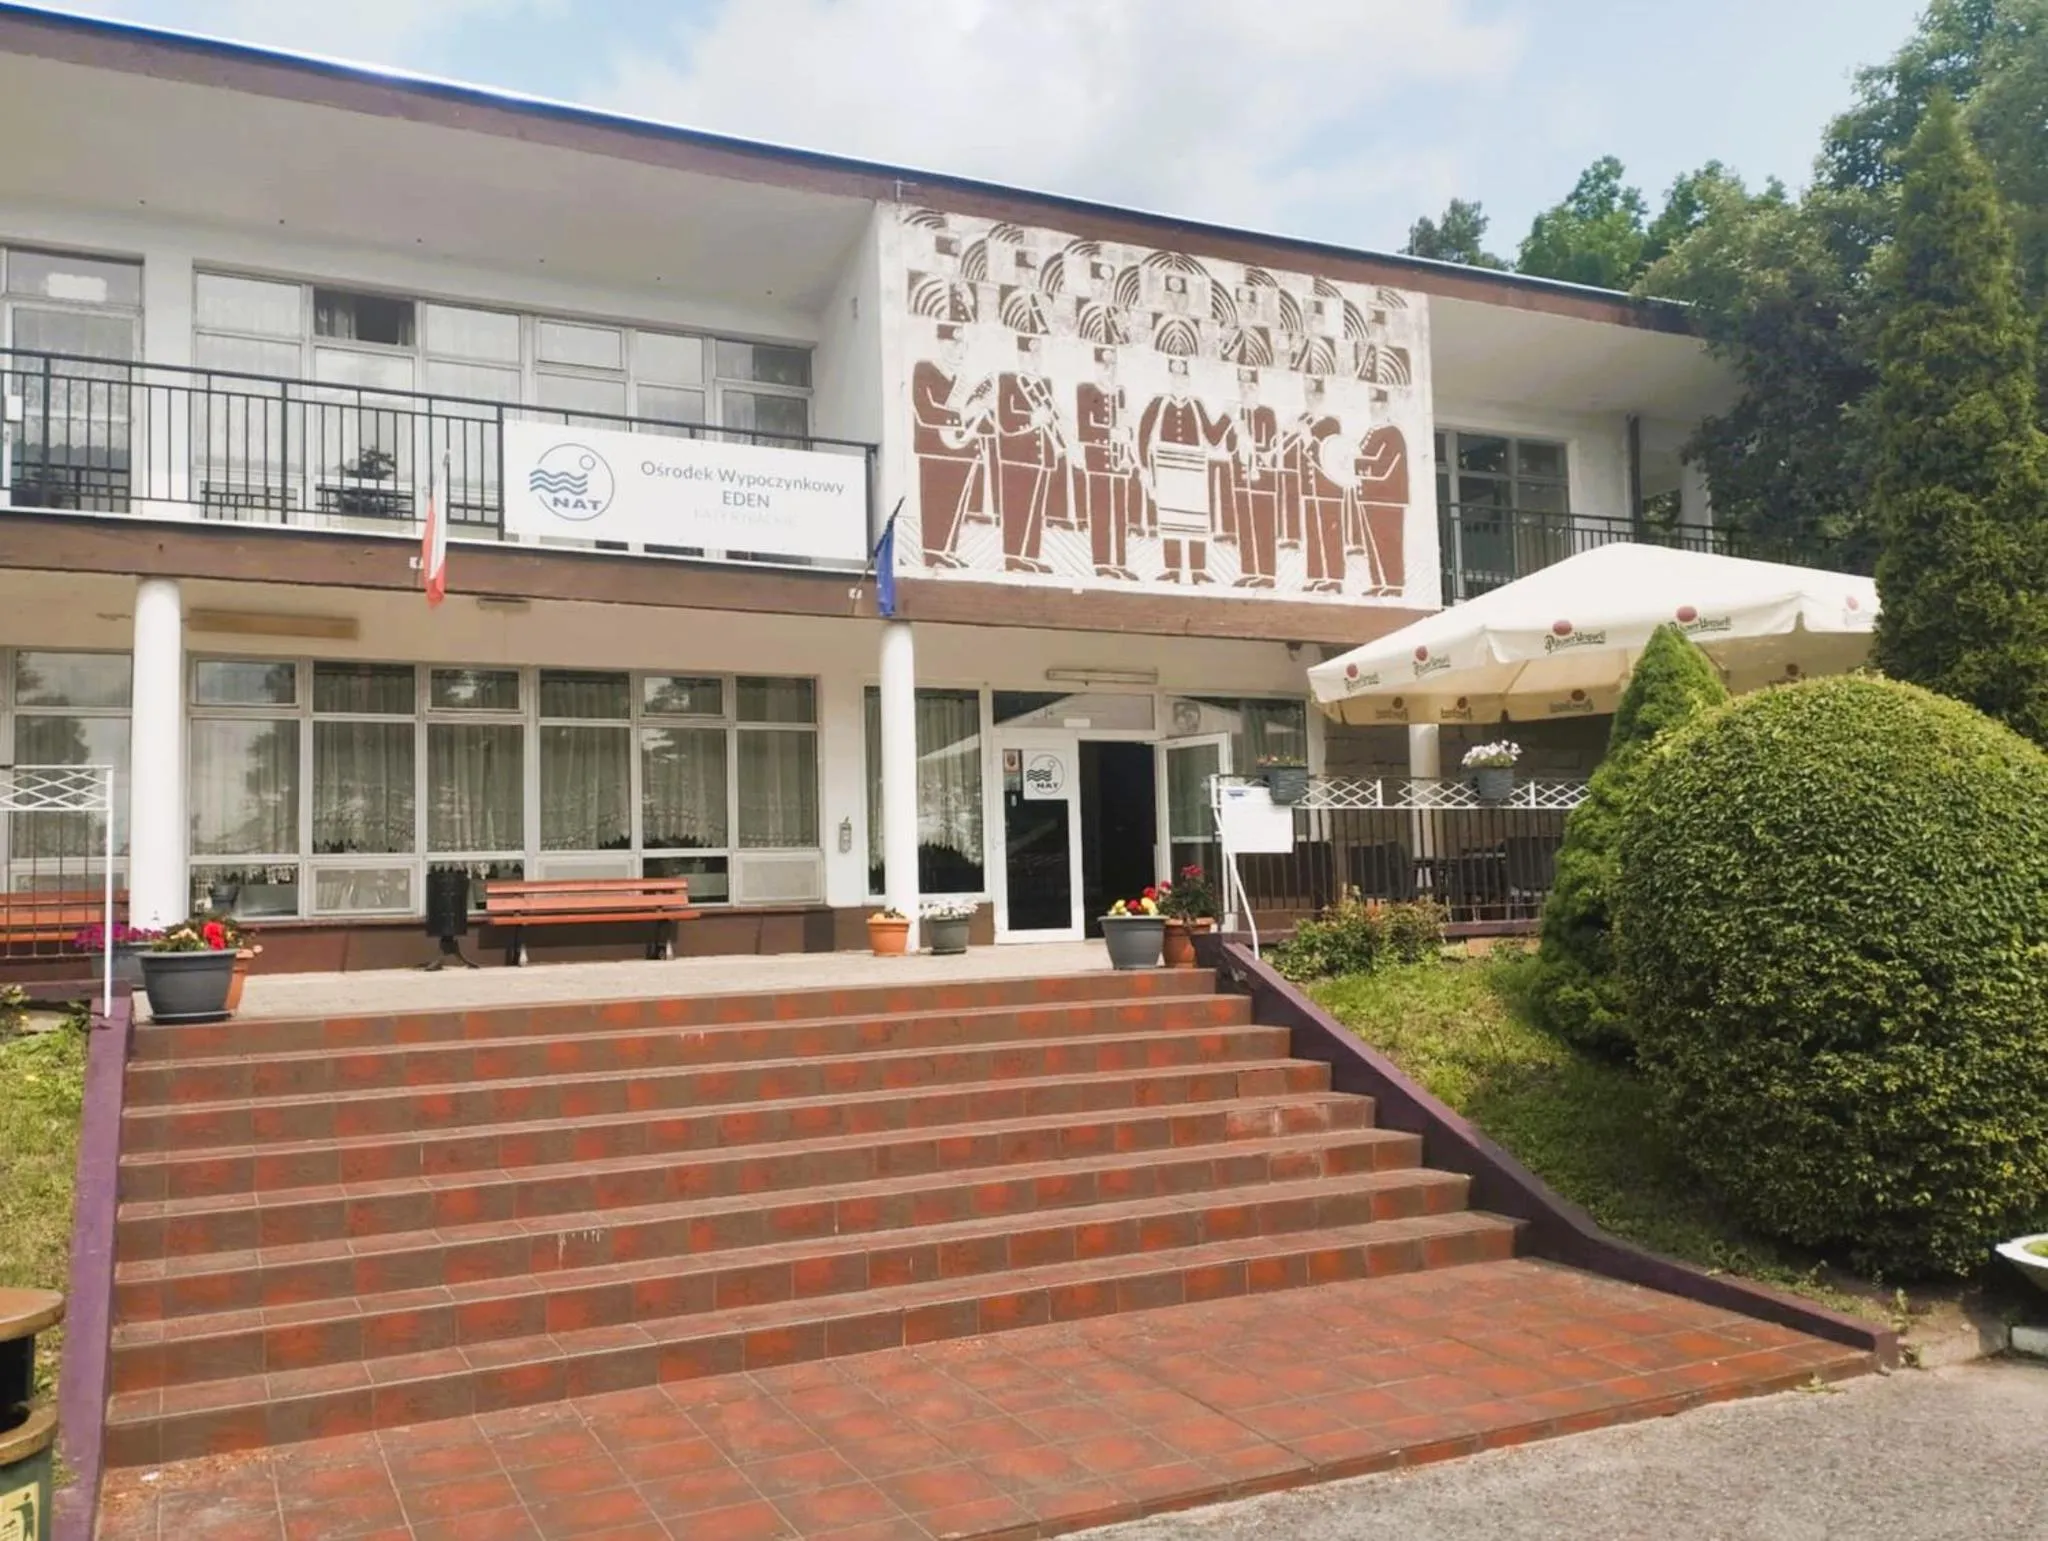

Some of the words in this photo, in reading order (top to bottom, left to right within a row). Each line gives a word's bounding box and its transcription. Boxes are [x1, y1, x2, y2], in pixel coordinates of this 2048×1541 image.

[641, 460, 713, 481] Ośrodek
[717, 468, 844, 495] Wypoczynkowy
[552, 497, 602, 511] NAT
[722, 490, 770, 508] EDEN
